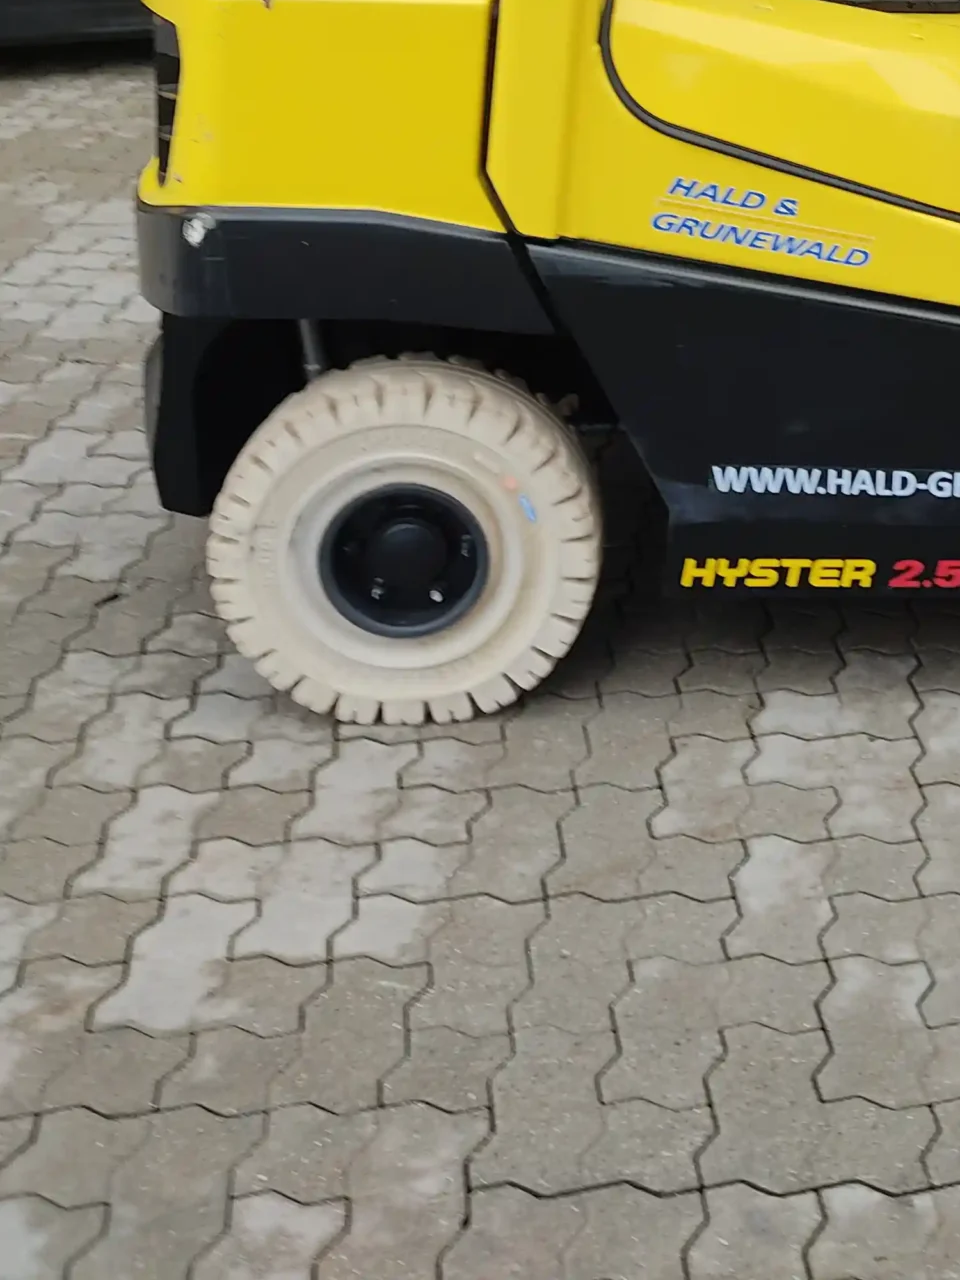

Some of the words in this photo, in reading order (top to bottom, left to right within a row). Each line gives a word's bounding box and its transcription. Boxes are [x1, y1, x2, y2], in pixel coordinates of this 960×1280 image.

[670, 178, 766, 210] HALD
[774, 198, 798, 217] &
[652, 213, 870, 267] GRUNEWALD
[680, 557, 877, 588] HYSTER
